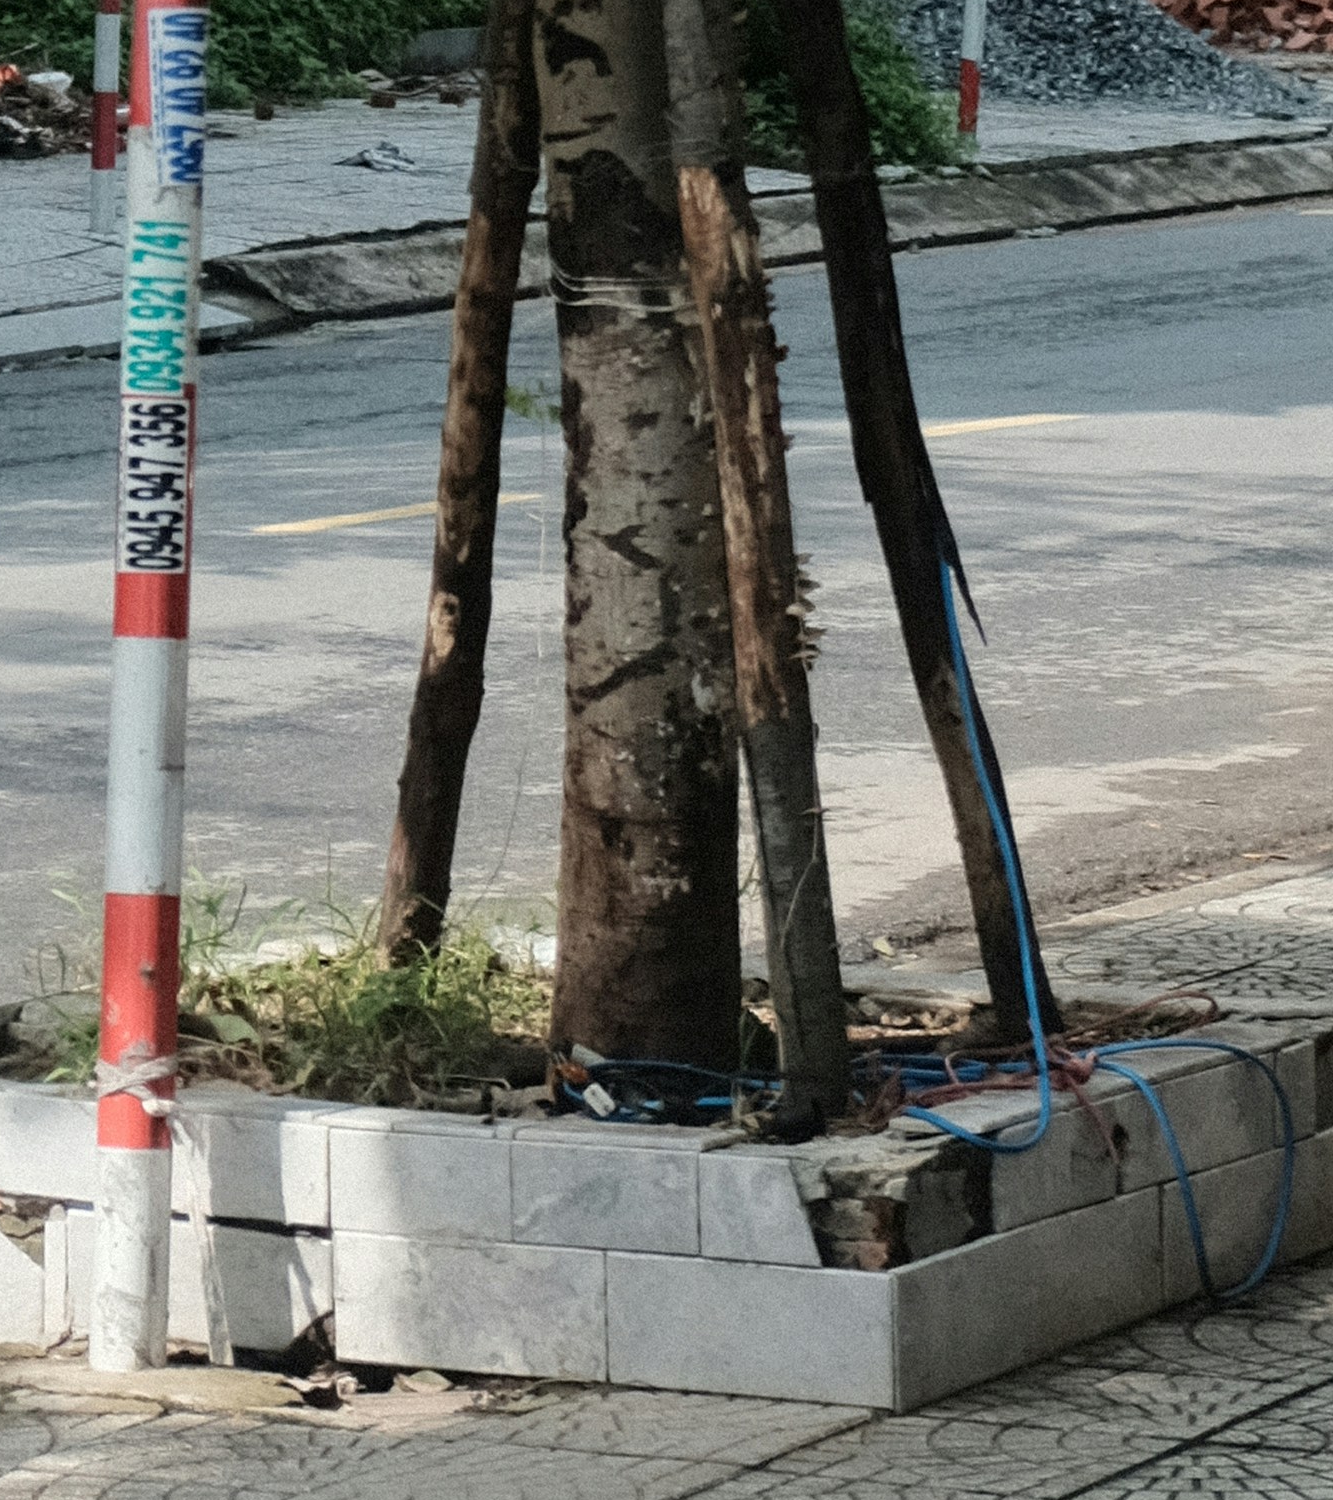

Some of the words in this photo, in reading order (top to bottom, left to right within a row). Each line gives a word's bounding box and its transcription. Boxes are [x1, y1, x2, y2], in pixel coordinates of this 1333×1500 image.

[130, 220, 190, 263] 741
[127, 275, 187, 321] 921
[125, 329, 185, 391] 0934
